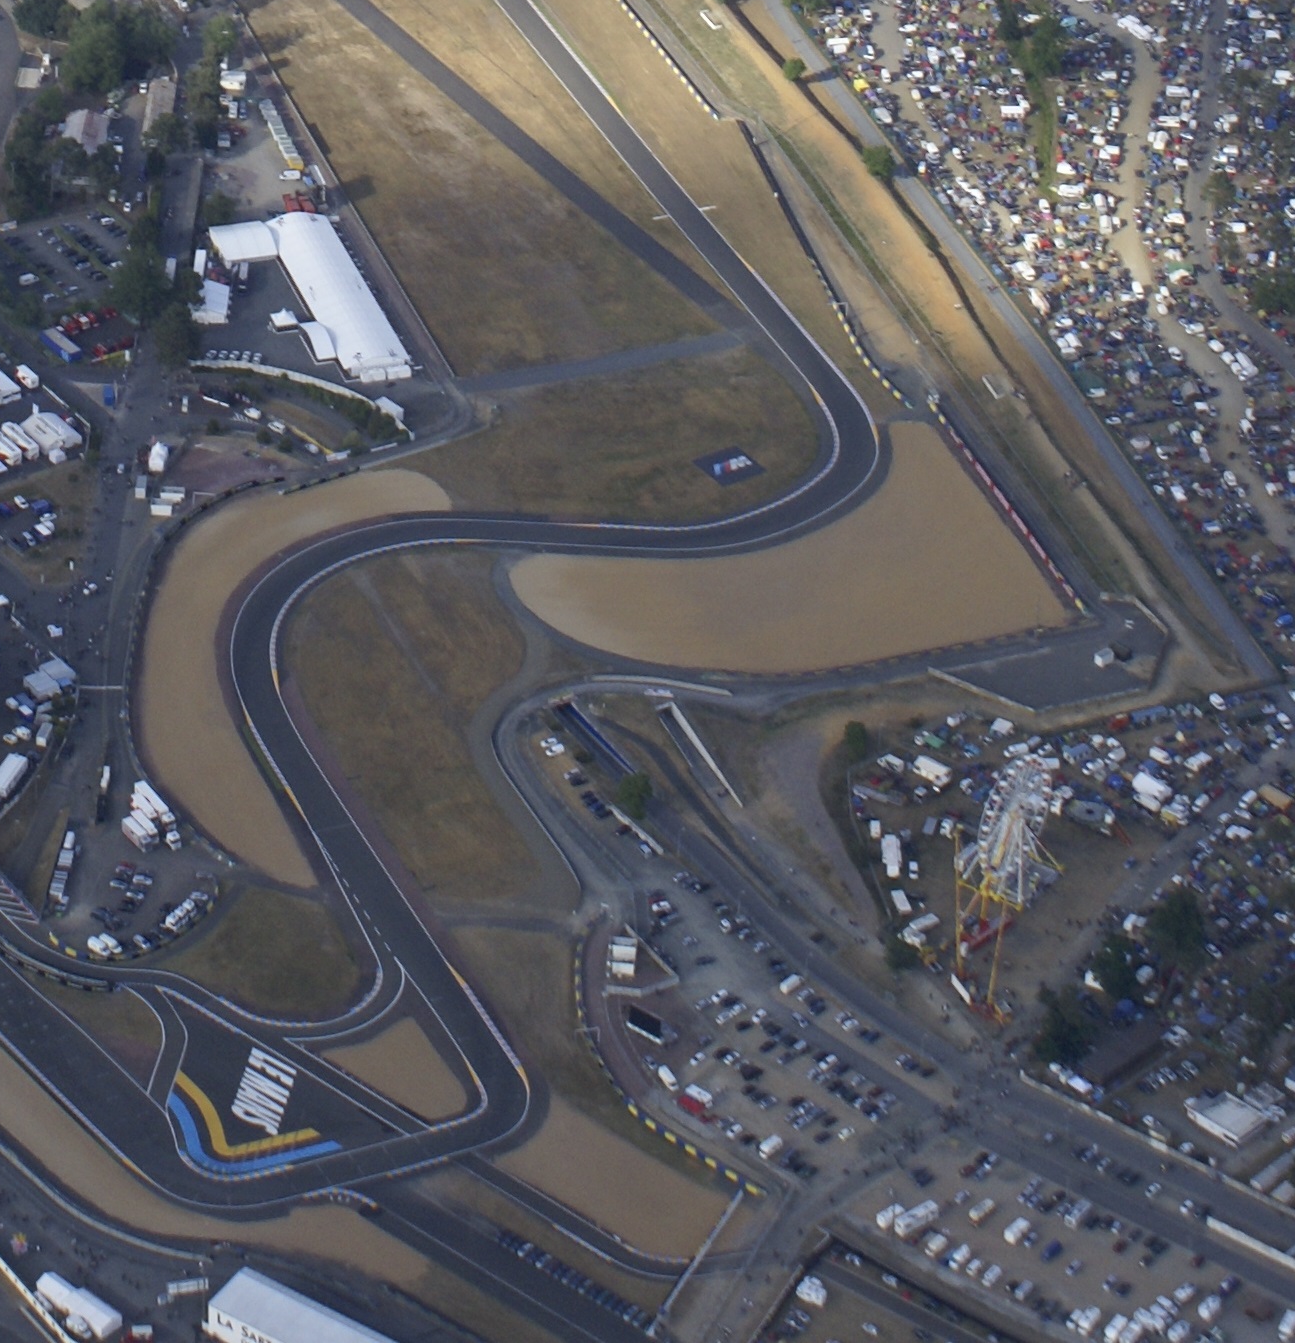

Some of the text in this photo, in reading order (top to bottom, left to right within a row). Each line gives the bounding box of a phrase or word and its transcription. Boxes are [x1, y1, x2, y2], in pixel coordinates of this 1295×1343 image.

[231, 1047, 297, 1135] LE MANS
[217, 1312, 234, 1331] LA
